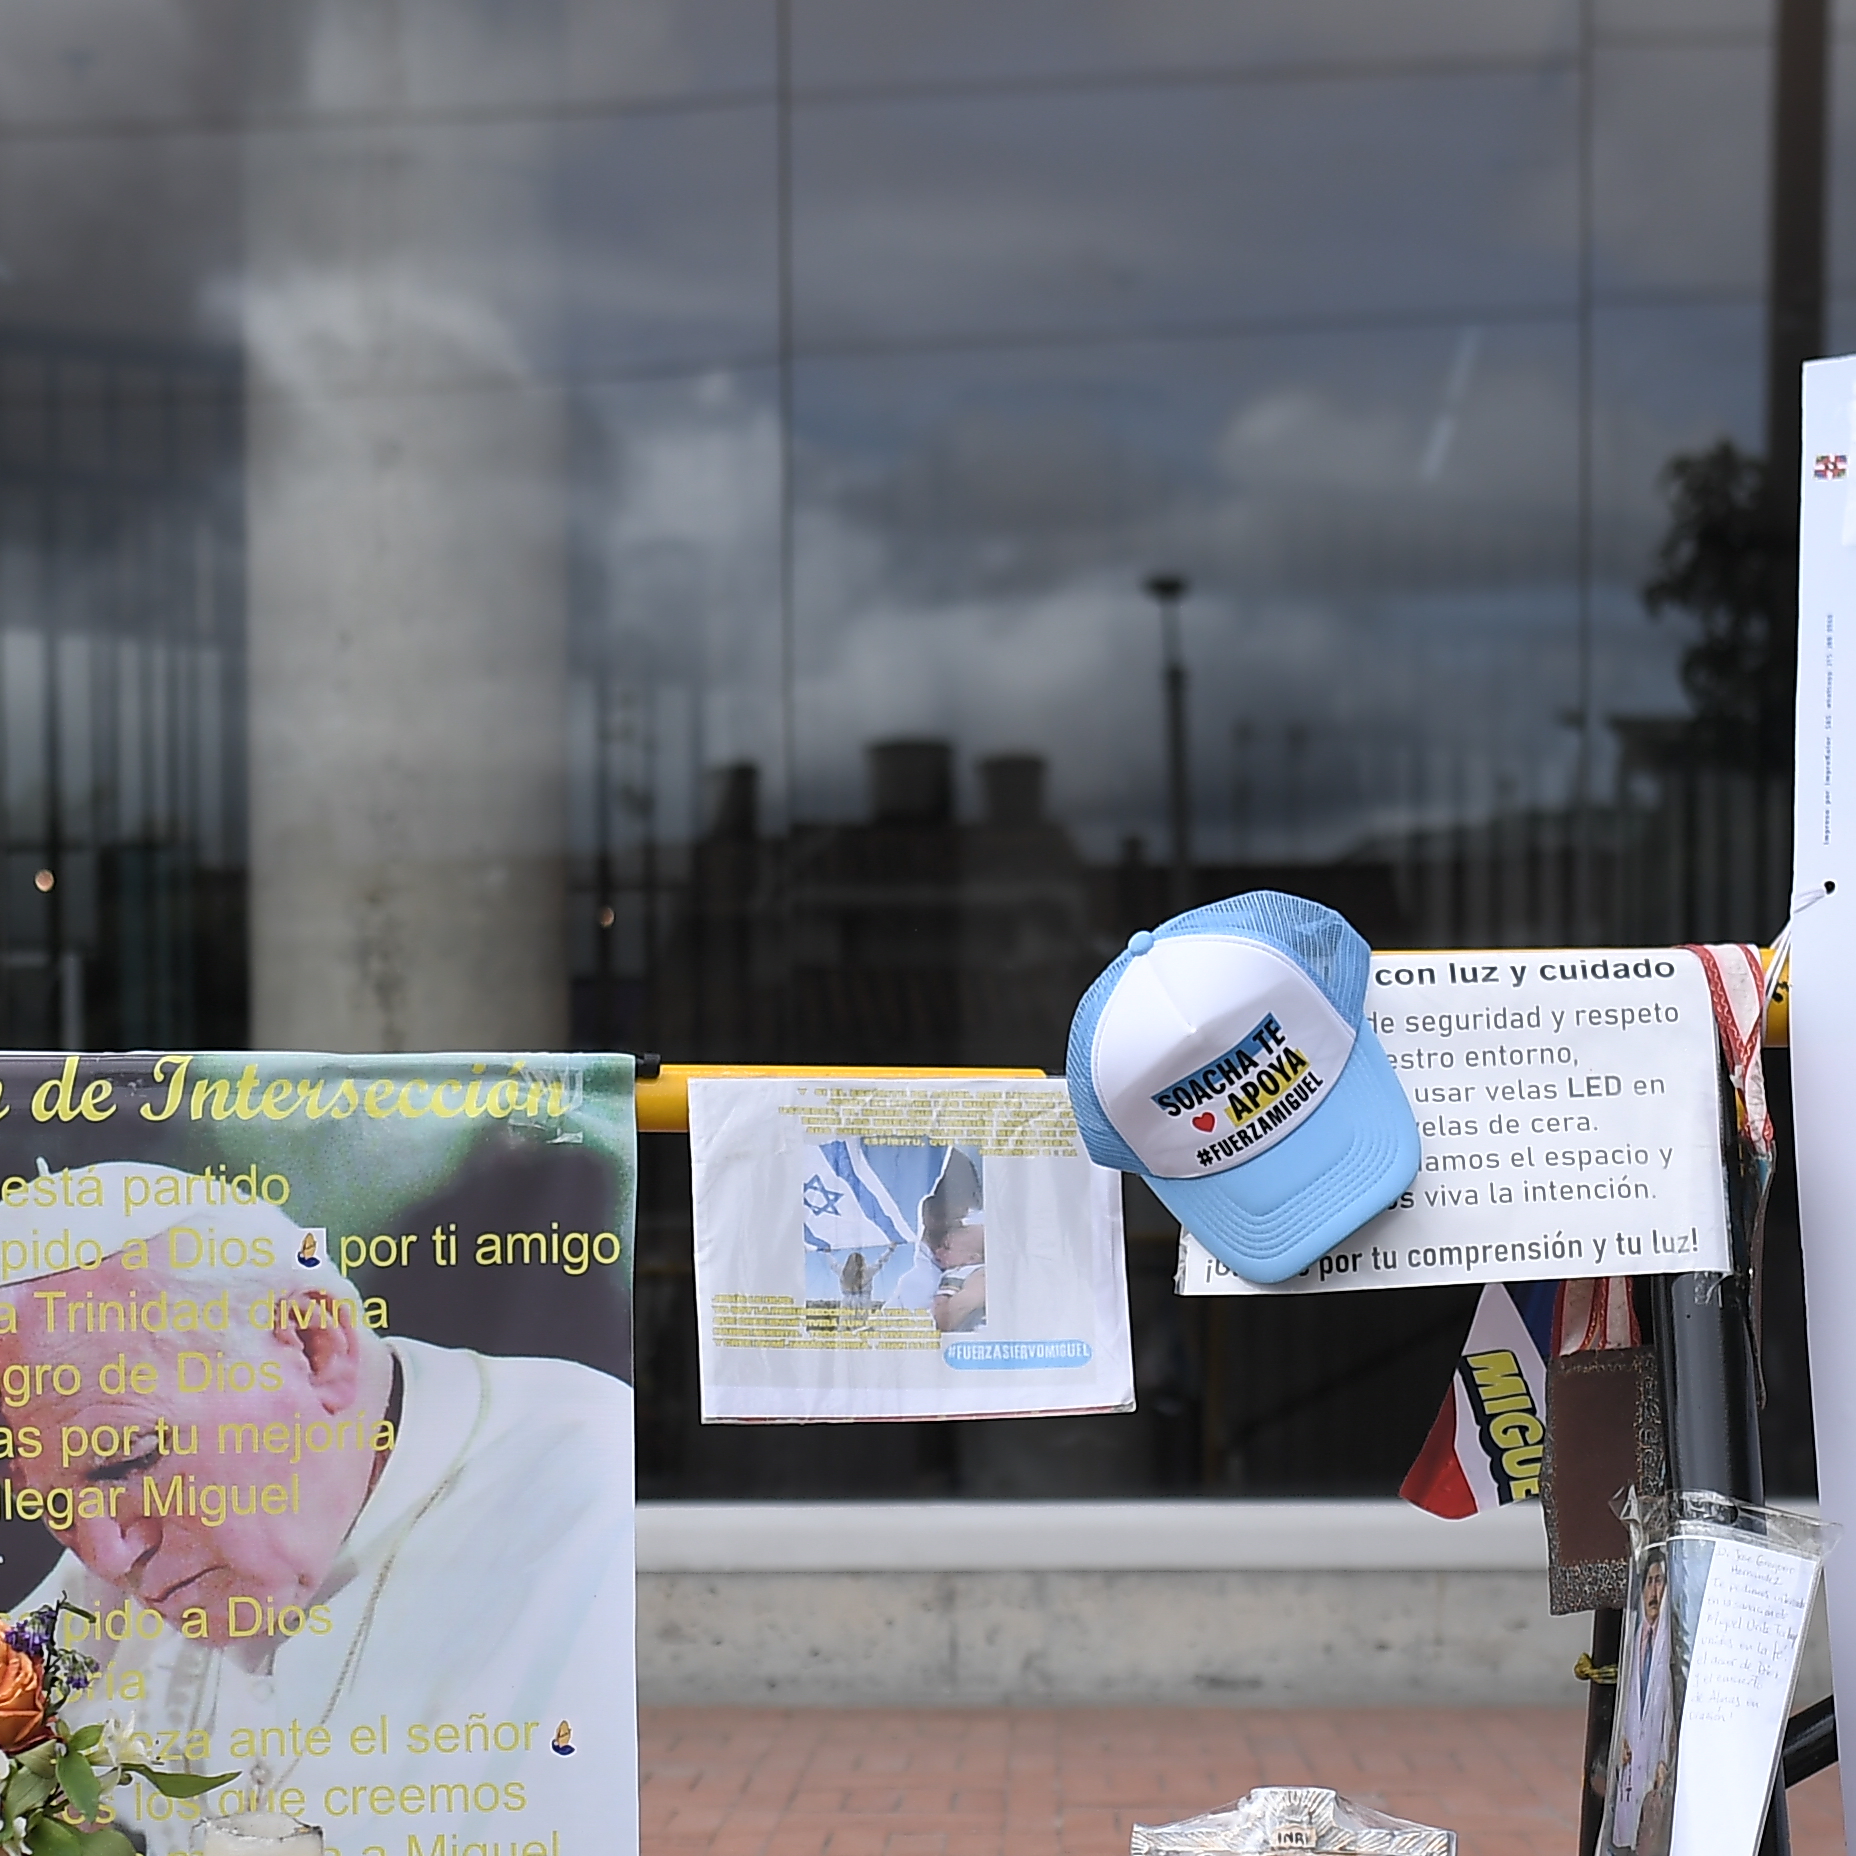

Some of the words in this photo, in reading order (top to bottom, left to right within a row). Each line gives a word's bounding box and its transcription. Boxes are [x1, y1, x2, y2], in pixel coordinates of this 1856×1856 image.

[1375, 966, 1436, 986] con
[1449, 961, 1500, 984] luz
[1510, 965, 1528, 987] y
[1539, 958, 1675, 981] cuidado
[1405, 1006, 1541, 1038] seguridad
[1551, 1009, 1566, 1033] y
[1575, 1002, 1679, 1030] respeto
[1158, 1048, 1260, 1118] SOACHA
[1252, 1018, 1286, 1056] TE
[1388, 1047, 1454, 1070] estro
[1465, 1045, 1579, 1067] entorno,
[31, 1055, 117, 1124] de
[139, 1054, 569, 1123] Intersección
[1227, 1046, 1307, 1122] APOYA
[1414, 1085, 1475, 1103] usar
[1485, 1079, 1558, 1101] velas
[1568, 1075, 1622, 1098] LED
[1633, 1078, 1665, 1096] en
[1196, 1071, 1324, 1167] #FUERZAMIGUEL
[1489, 1113, 1519, 1136] de
[1530, 1115, 1599, 1136] cera.
[1510, 1146, 1535, 1167] el
[1544, 1145, 1649, 1171] espacio
[1659, 1146, 1674, 1171] y
[1, 1166, 105, 1209] está
[124, 1163, 291, 1216] partido
[1424, 1184, 1478, 1206] viva
[1489, 1181, 1514, 1204] la
[1523, 1178, 1657, 1203] intención.
[1, 1229, 103, 1280] pido
[120, 1239, 149, 1270] a
[168, 1226, 276, 1269] Dios
[340, 1232, 418, 1277] por
[431, 1224, 458, 1267] ti
[475, 1221, 621, 1276] amigo
[1318, 1251, 1363, 1282] por
[1371, 1244, 1398, 1270] tu
[1407, 1230, 1584, 1273] comprensión
[1592, 1238, 1607, 1265] y
[1615, 1230, 1642, 1257] tu
[1651, 1227, 1699, 1255] luz!
[33, 1288, 229, 1333] Trinidad
[248, 1288, 390, 1331] divina
[99, 1353, 159, 1395] de
[178, 1350, 284, 1394] Dios
[61, 1422, 140, 1468] por
[155, 1416, 198, 1456] tu
[218, 1410, 395, 1464] mejoría
[1466, 1351, 1544, 1502] MIGUE
[143, 1473, 300, 1528] Miguel
[63, 1599, 164, 1651] pido
[181, 1607, 210, 1639] a
[228, 1596, 333, 1639] Dios
[229, 1717, 333, 1758] ante
[349, 1713, 389, 1756] el
[406, 1712, 540, 1755] señor
[135, 1778, 201, 1822] los
[323, 1779, 527, 1817] creemos
